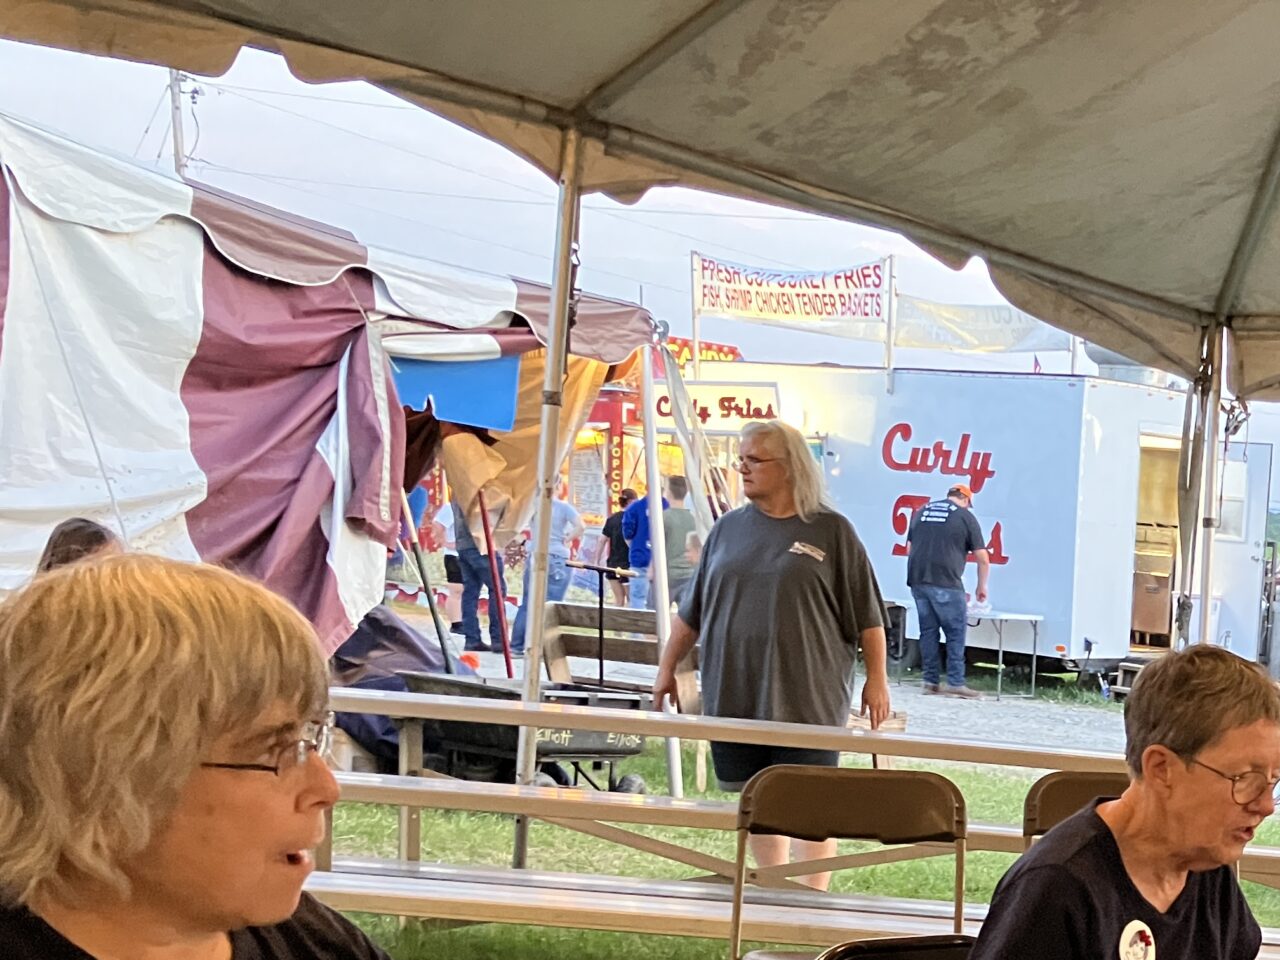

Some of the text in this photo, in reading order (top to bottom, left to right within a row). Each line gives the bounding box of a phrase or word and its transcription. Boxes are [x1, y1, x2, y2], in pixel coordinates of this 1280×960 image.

[702, 258, 742, 284] FRESH
[834, 264, 882, 288] FRIES
[755, 291, 795, 315] CHICKEN
[795, 293, 838, 316] TENDER
[839, 293, 881, 317] BASKETS
[656, 396, 711, 424] Cly
[718, 397, 777, 419] Fries
[882, 423, 996, 494] Curly
[611, 436, 622, 513] POPCORN
